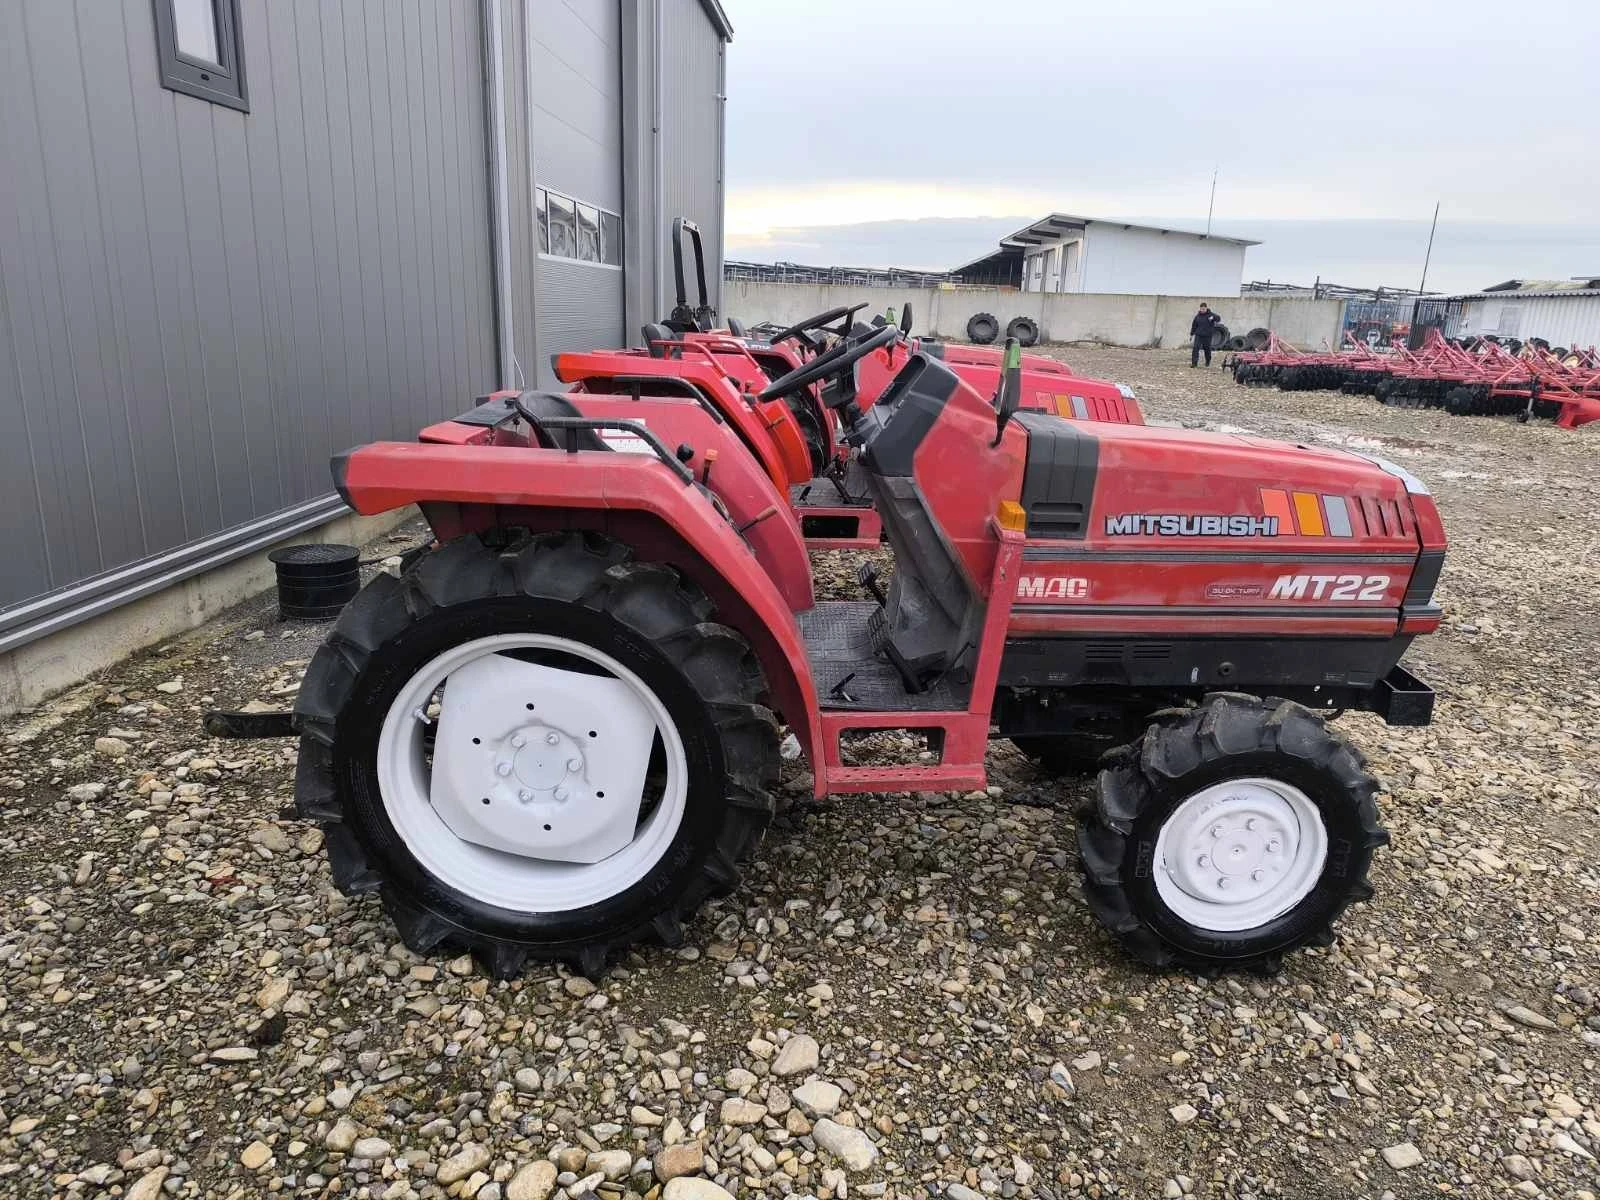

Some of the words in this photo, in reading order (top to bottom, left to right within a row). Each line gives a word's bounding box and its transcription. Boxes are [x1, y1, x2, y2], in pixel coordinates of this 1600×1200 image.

[1105, 514, 1279, 537] MITSUBISHI
[1016, 576, 1087, 598] MAC
[1266, 574, 1390, 600] MT22
